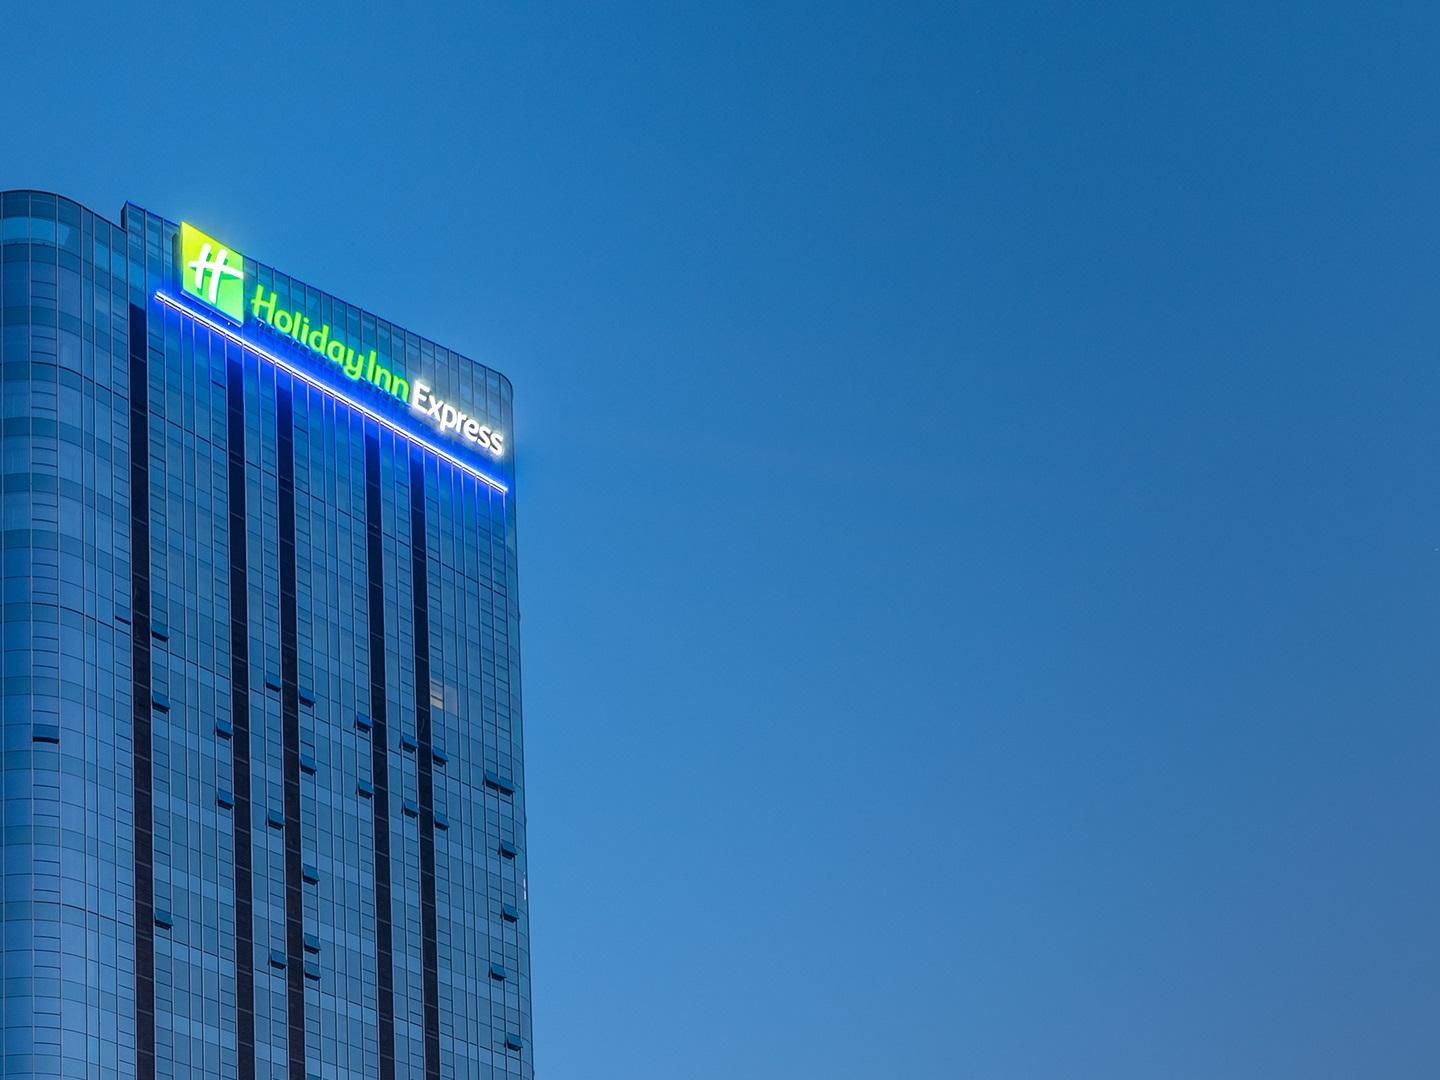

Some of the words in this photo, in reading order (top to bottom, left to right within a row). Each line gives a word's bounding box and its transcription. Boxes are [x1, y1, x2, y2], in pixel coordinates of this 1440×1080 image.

[250, 283, 366, 380] Holiday
[367, 350, 410, 402] Inn
[411, 379, 505, 457] Express
